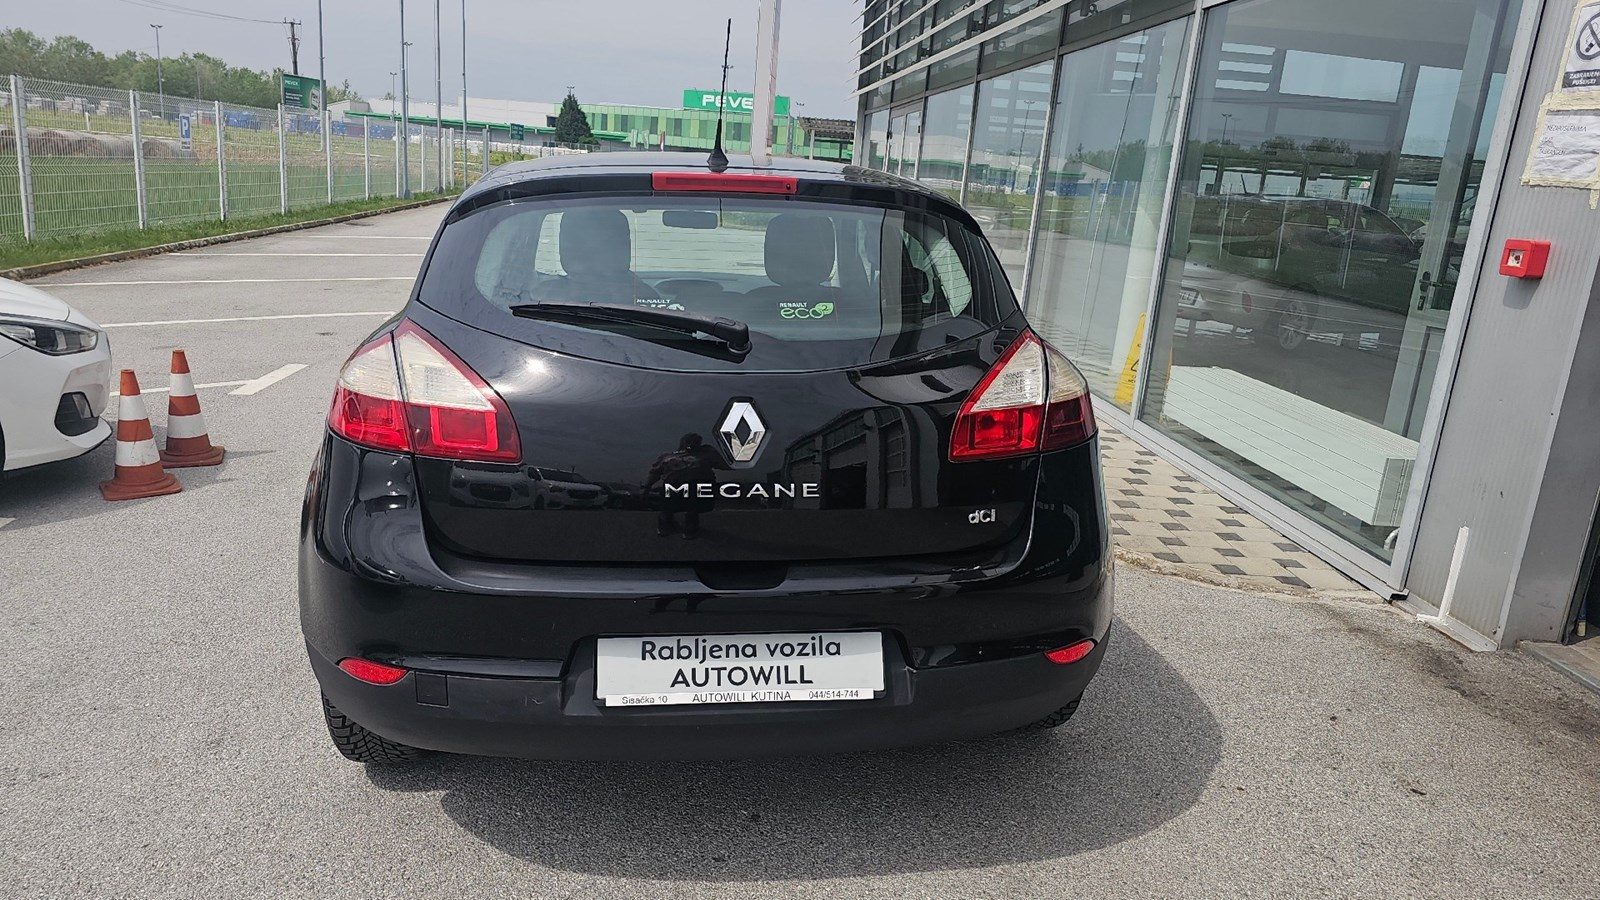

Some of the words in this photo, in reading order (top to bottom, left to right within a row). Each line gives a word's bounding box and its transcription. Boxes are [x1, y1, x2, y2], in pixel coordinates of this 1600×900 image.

[1569, 71, 1600, 79] ZABRANJEN
[702, 94, 754, 109] PEVE
[182, 118, 188, 135] P
[664, 483, 820, 499] MEGANE
[641, 637, 757, 664] Rabljena
[765, 635, 841, 658] vozila
[670, 665, 813, 688] AUTOWILL
[621, 696, 655, 705] Sisačka
[658, 695, 668, 704] 10
[751, 691, 792, 702] KUTINA
[808, 690, 859, 700] 044/514-744
